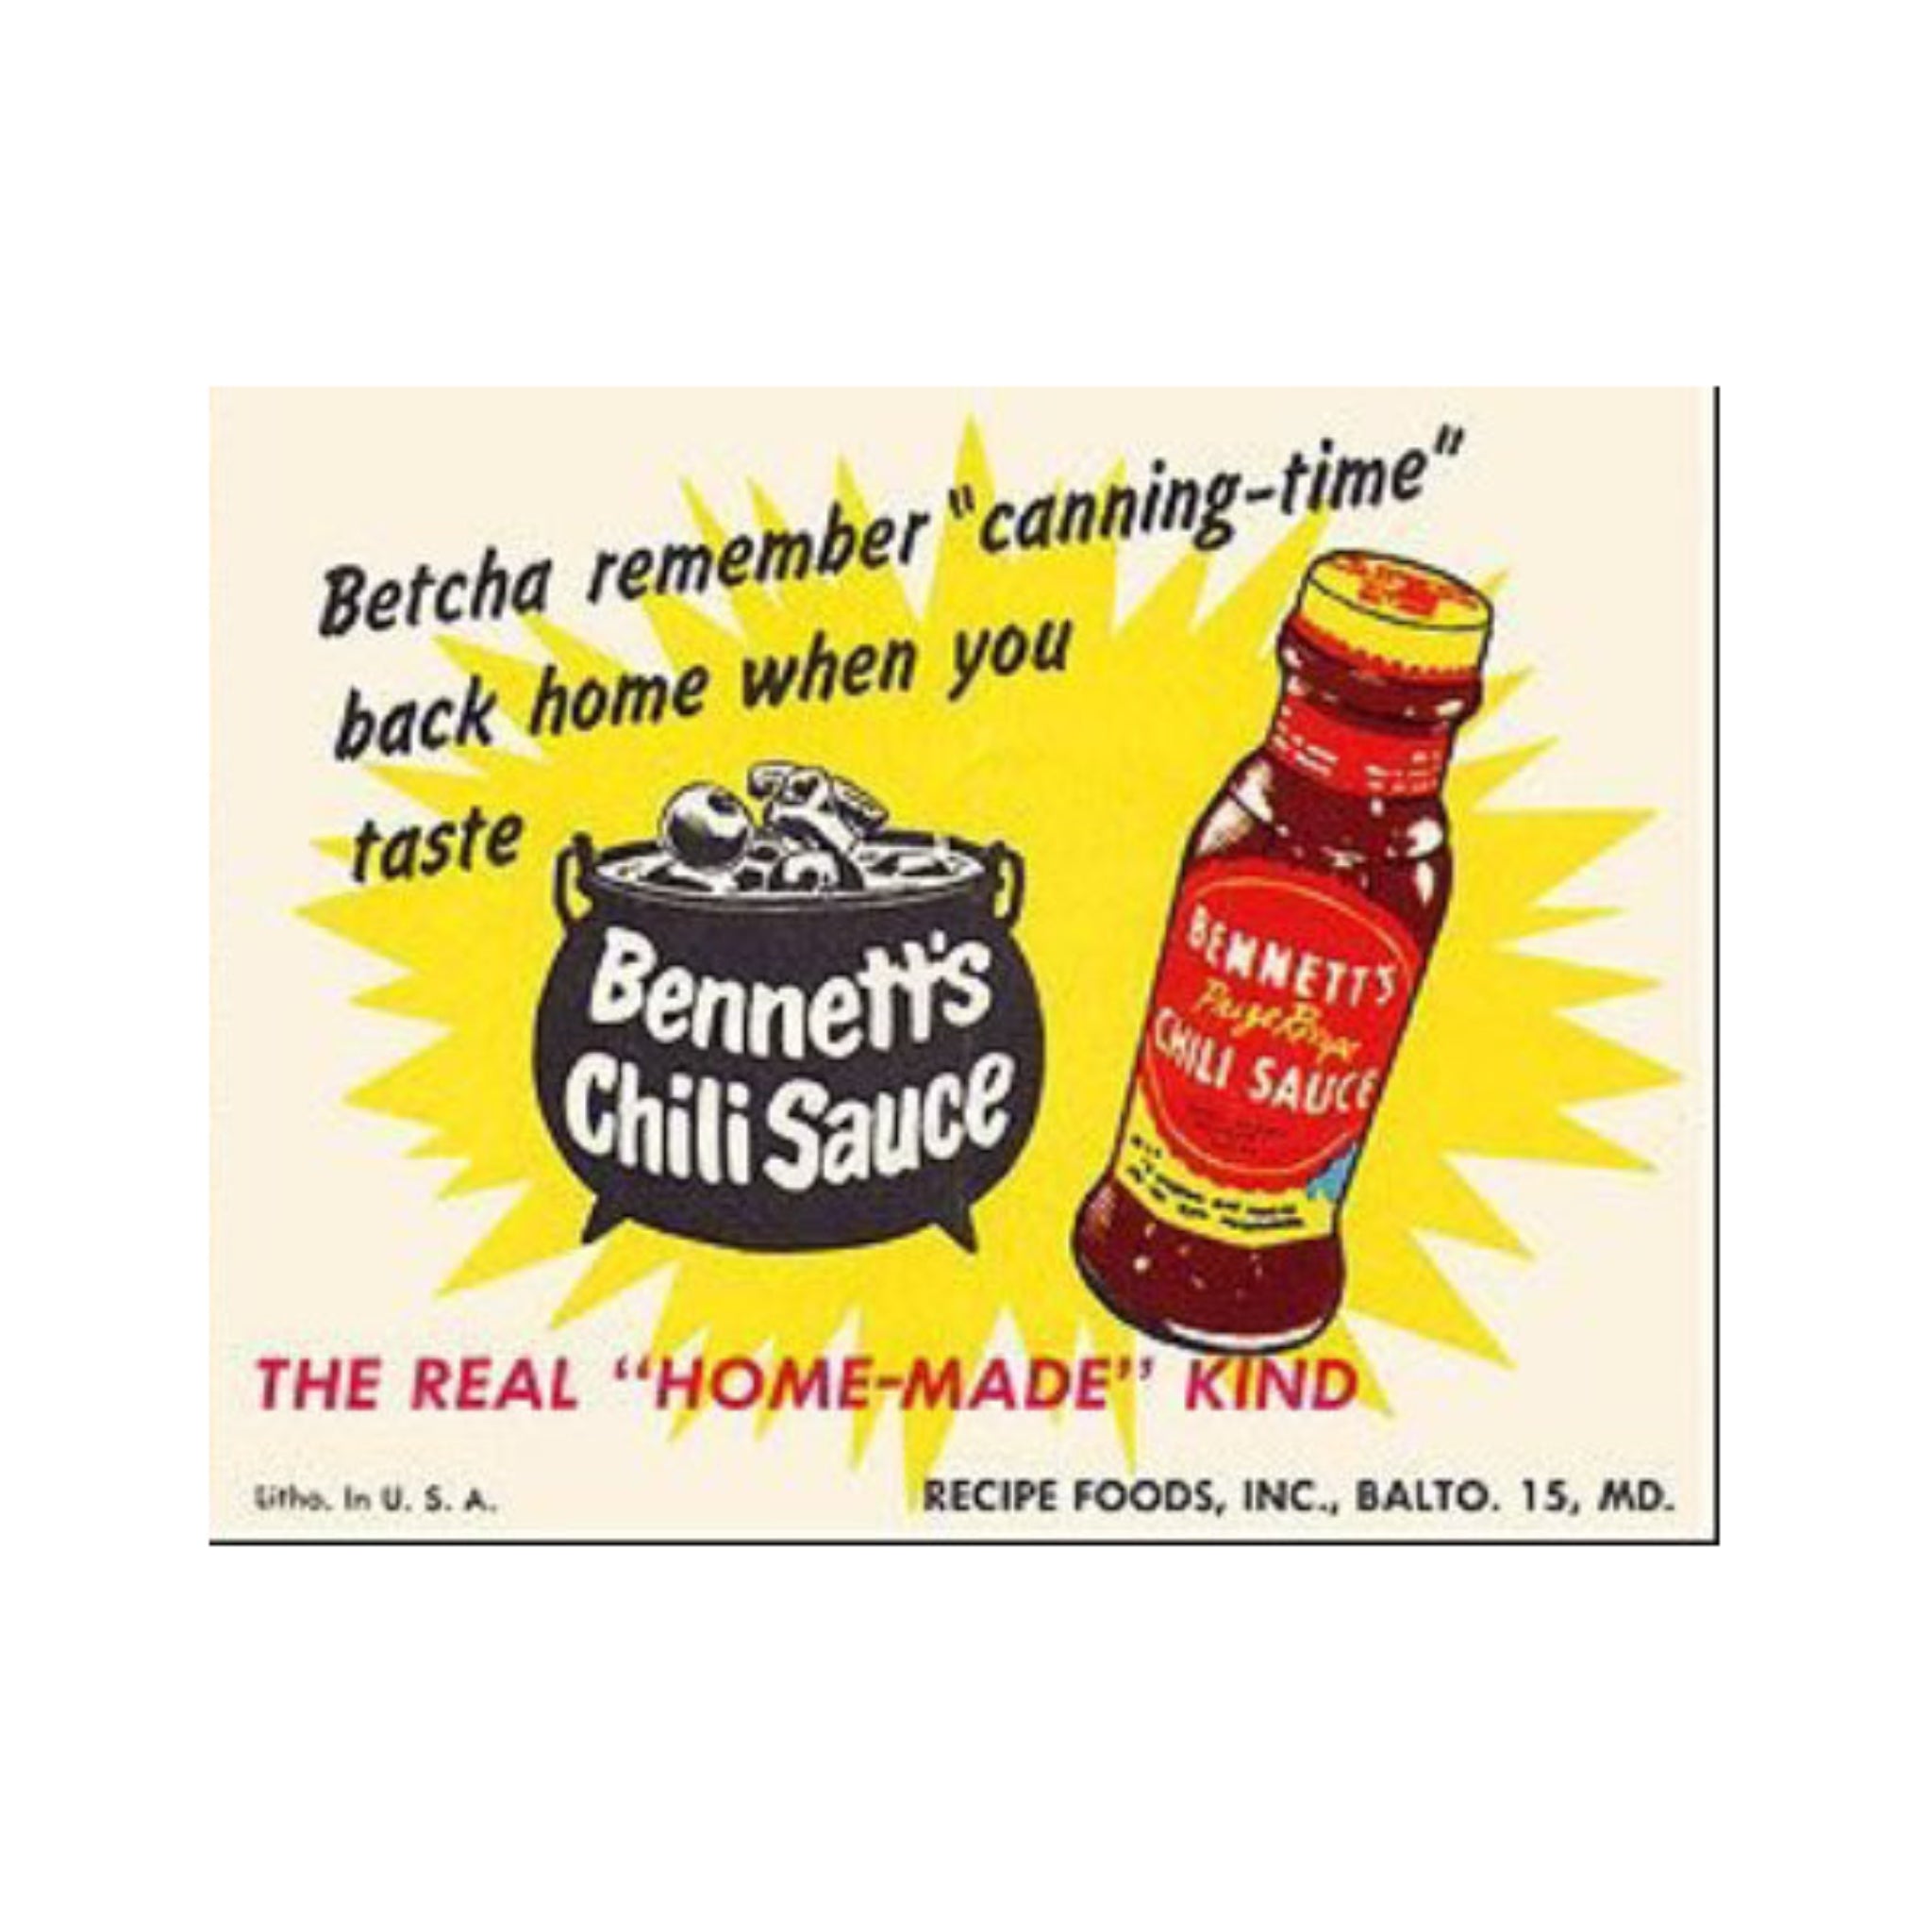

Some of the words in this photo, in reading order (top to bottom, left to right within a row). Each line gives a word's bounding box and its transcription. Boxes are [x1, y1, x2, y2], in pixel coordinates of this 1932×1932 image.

[318, 546, 553, 639] Betcha
[586, 501, 931, 605] remember
[333, 674, 497, 762] back
[528, 663, 709, 737] home
[741, 630, 917, 708] when
[947, 619, 1073, 702] you
[352, 806, 524, 884] taste
[590, 926, 993, 1058] Bennett's
[1153, 1006, 1235, 1089] CHILI
[1248, 1056, 1380, 1116] SAUCE
[564, 1041, 755, 1186] Chili
[762, 1051, 1016, 1192] Sauce
[256, 1356, 383, 1412] THE
[409, 1357, 577, 1412] REAL
[1184, 1355, 1360, 1412] KIND
[379, 1485, 413, 1513] U.
[423, 1483, 453, 1514] S.
[462, 1487, 498, 1513] A.
[923, 1478, 1058, 1512] RECIPE
[1074, 1478, 1224, 1517] FOODS,
[1244, 1478, 1339, 1516] INC.,
[1357, 1478, 1501, 1512] BALTO.
[1522, 1478, 1580, 1515] 15,
[1598, 1478, 1675, 1512] MD.
